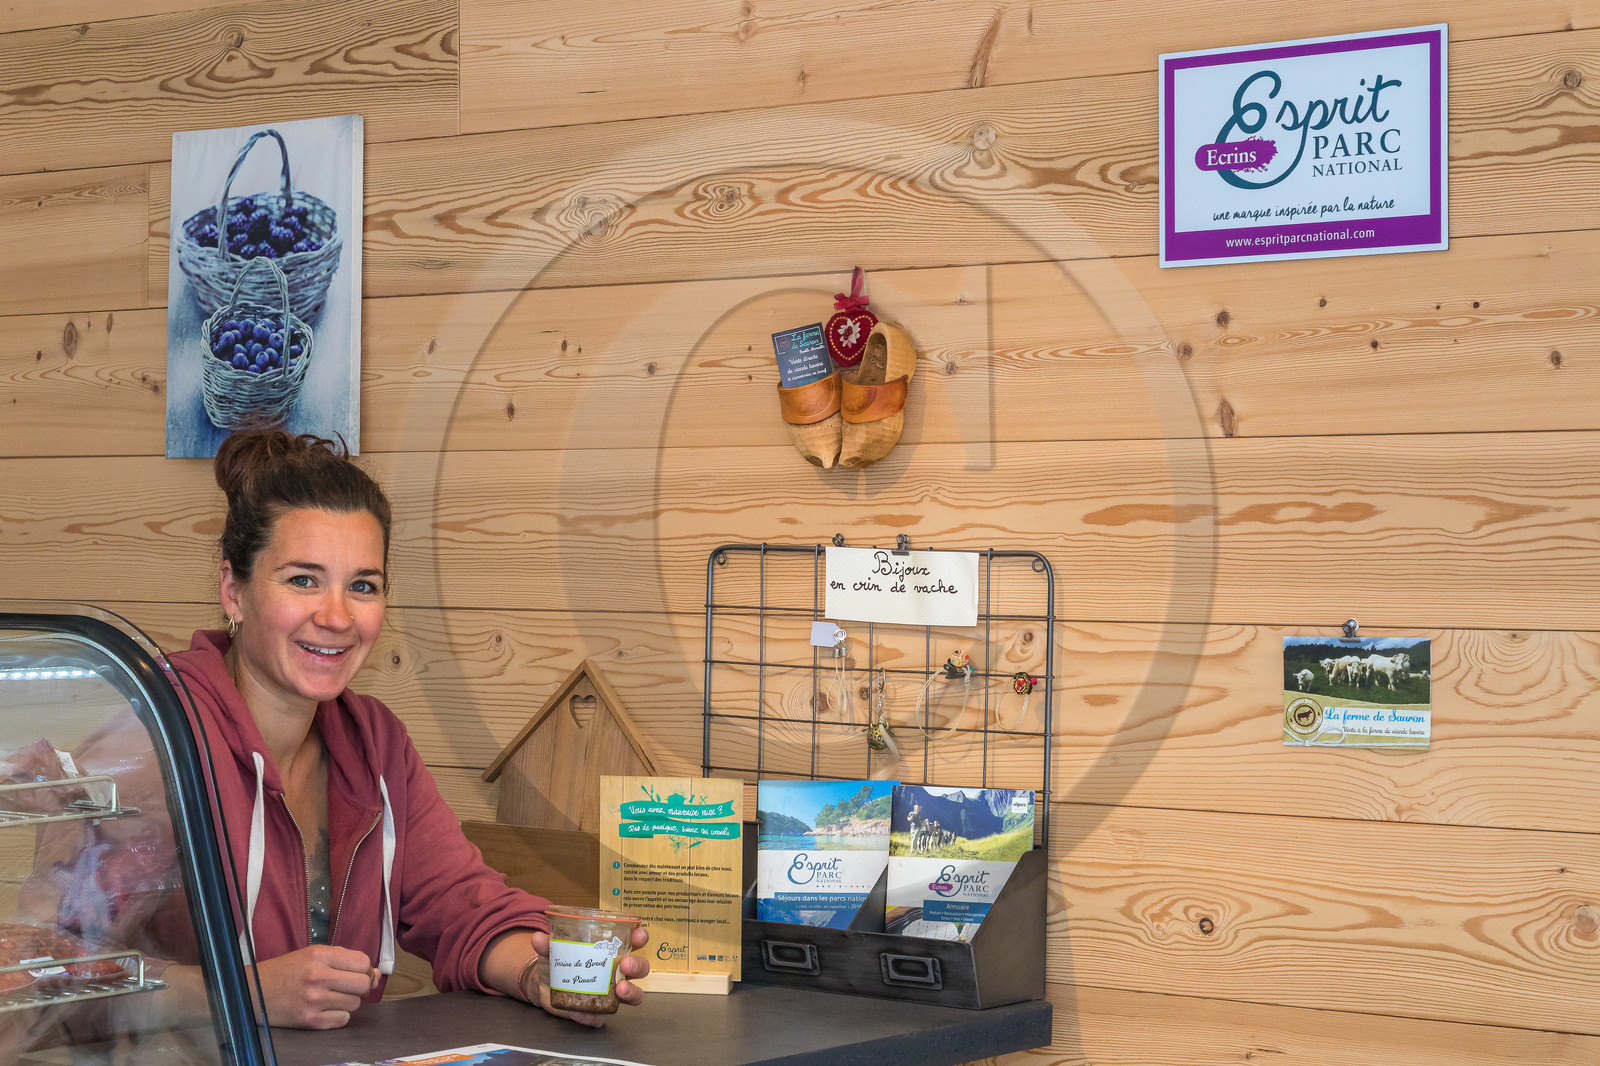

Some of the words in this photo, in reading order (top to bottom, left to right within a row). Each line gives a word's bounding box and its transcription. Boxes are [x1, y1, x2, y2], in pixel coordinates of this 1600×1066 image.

[1215, 70, 1402, 189] Esprit
[1312, 129, 1401, 159] PARC
[1206, 147, 1257, 166] Ecrins
[1312, 158, 1402, 177] NATIONAL
[1213, 211, 1230, 221] une
[1233, 207, 1272, 221] marque
[1276, 201, 1318, 219] inspirée
[1320, 203, 1340, 217] par
[1343, 196, 1355, 212] la
[1358, 195, 1395, 211] nature
[1226, 228, 1375, 248] www.espritparcnational.com
[872, 551, 930, 582] Bijoux
[830, 580, 846, 590] en
[853, 577, 882, 592] crin
[890, 581, 906, 593] de
[914, 579, 958, 594] vache
[1325, 707, 1340, 720] La
[1343, 709, 1370, 724] ferme
[1373, 711, 1385, 721] de
[1388, 709, 1424, 722] Sauron
[1369, 726, 1383, 735] ferme
[628, 806, 646, 815] Vous
[787, 853, 842, 885] Esprit
[935, 865, 990, 898] Esprit
[963, 885, 990, 893] PARC
[657, 942, 688, 960] Esprit
[574, 959, 582, 968] de
[572, 975, 598, 985] Piment
